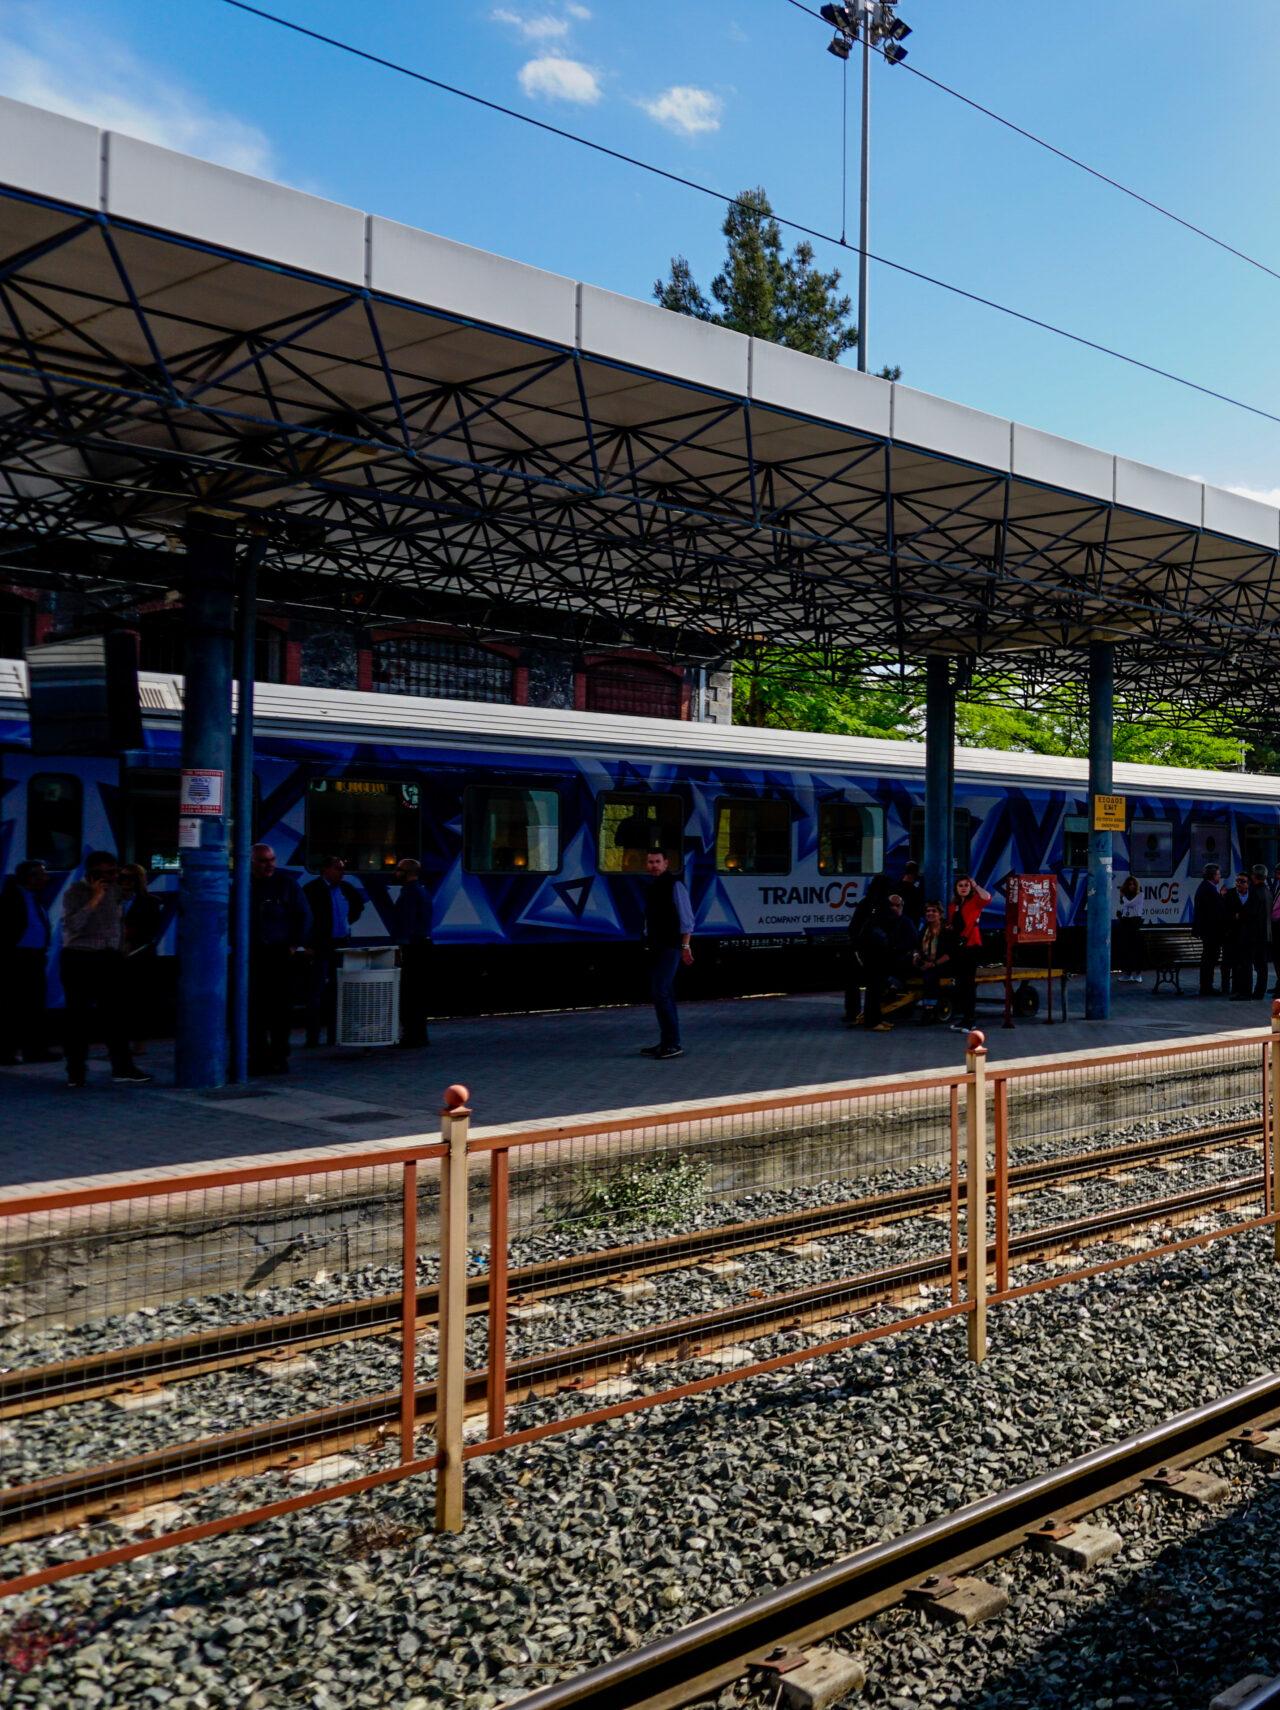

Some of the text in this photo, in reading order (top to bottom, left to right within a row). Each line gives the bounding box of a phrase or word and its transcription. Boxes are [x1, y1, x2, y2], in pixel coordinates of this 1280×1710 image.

[1097, 796, 1123, 804] ΕΞΟΔΟΣ
[758, 916, 764, 924] A
[765, 915, 801, 924] COMPANY
[802, 915, 811, 923] OF
[813, 914, 826, 923] THE
